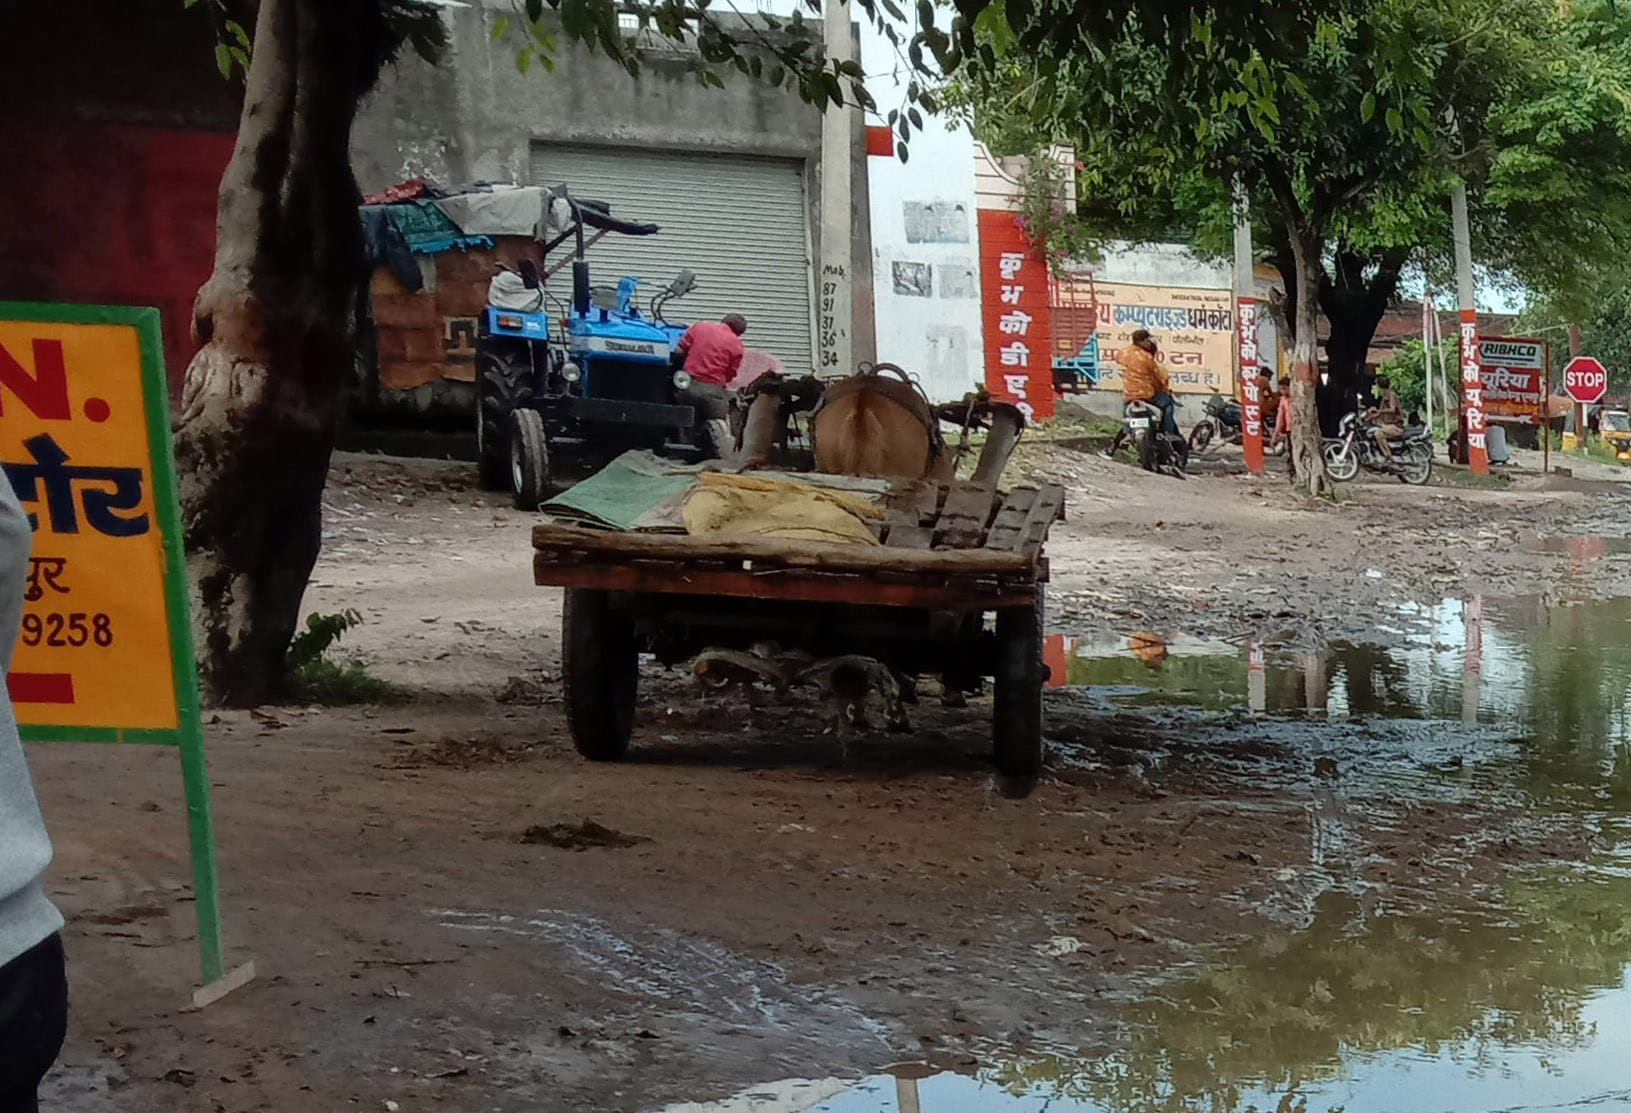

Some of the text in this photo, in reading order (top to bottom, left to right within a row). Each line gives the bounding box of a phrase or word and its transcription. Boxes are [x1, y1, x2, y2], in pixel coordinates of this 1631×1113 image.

[823, 282, 836, 295] 87
[822, 350, 838, 367] 34
[1169, 352, 1203, 365] टन
[1566, 371, 1604, 388] STOP
